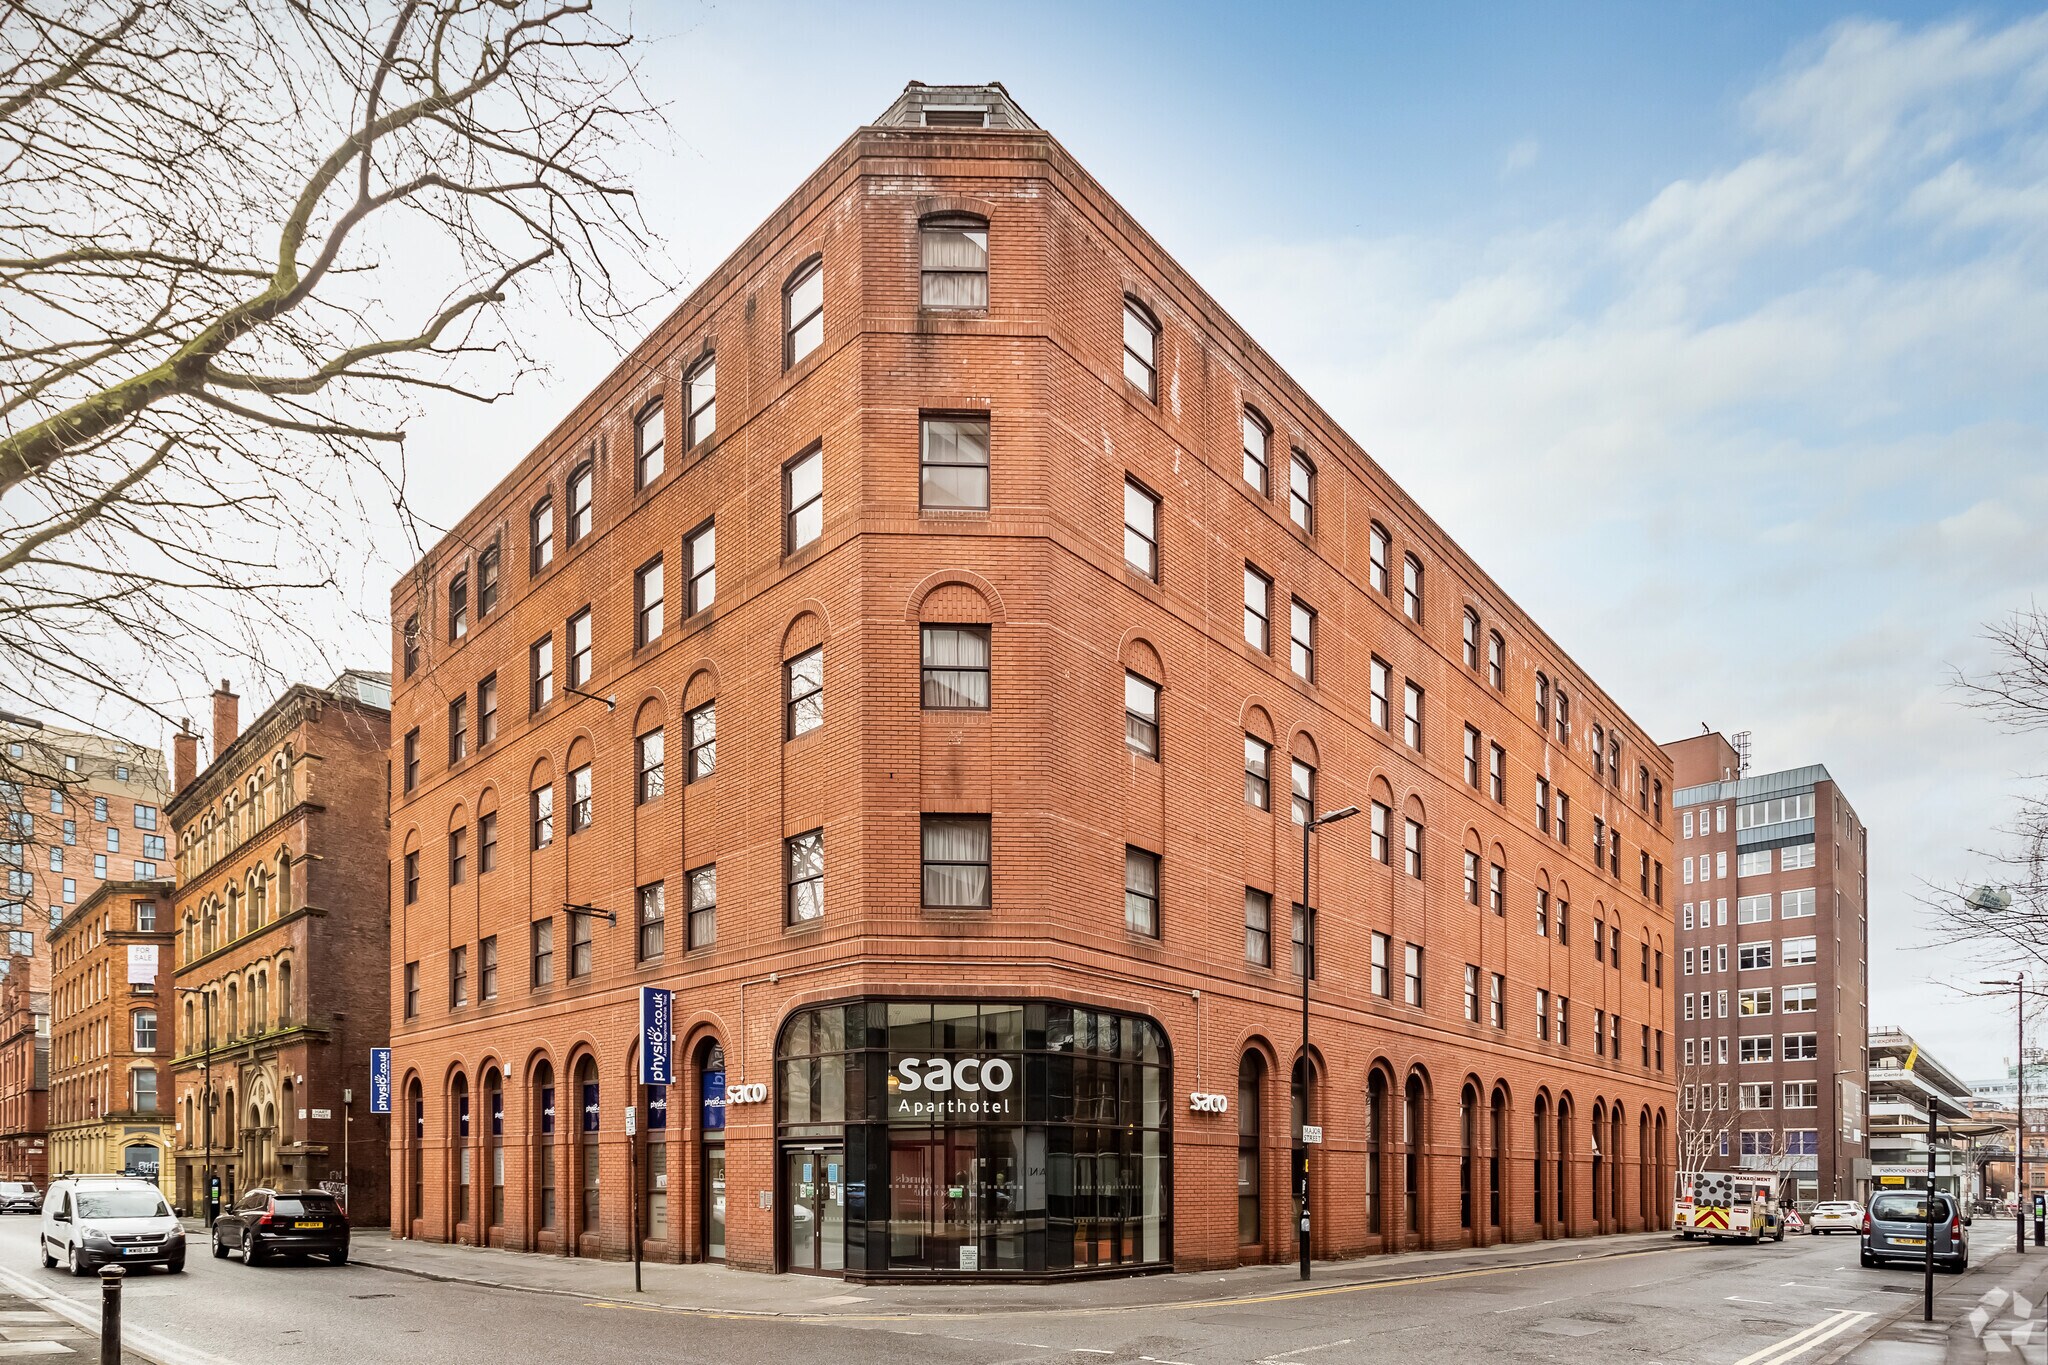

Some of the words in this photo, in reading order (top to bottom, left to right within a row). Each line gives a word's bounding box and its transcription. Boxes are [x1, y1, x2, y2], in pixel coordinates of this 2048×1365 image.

[650, 992, 666, 1082] physio.co.uk
[376, 1051, 389, 1111] physio.co.uk
[897, 1057, 1013, 1092] saco
[726, 1082, 768, 1104] saco
[898, 1098, 1010, 1116] Aparthotel
[1190, 1092, 1228, 1113] saco
